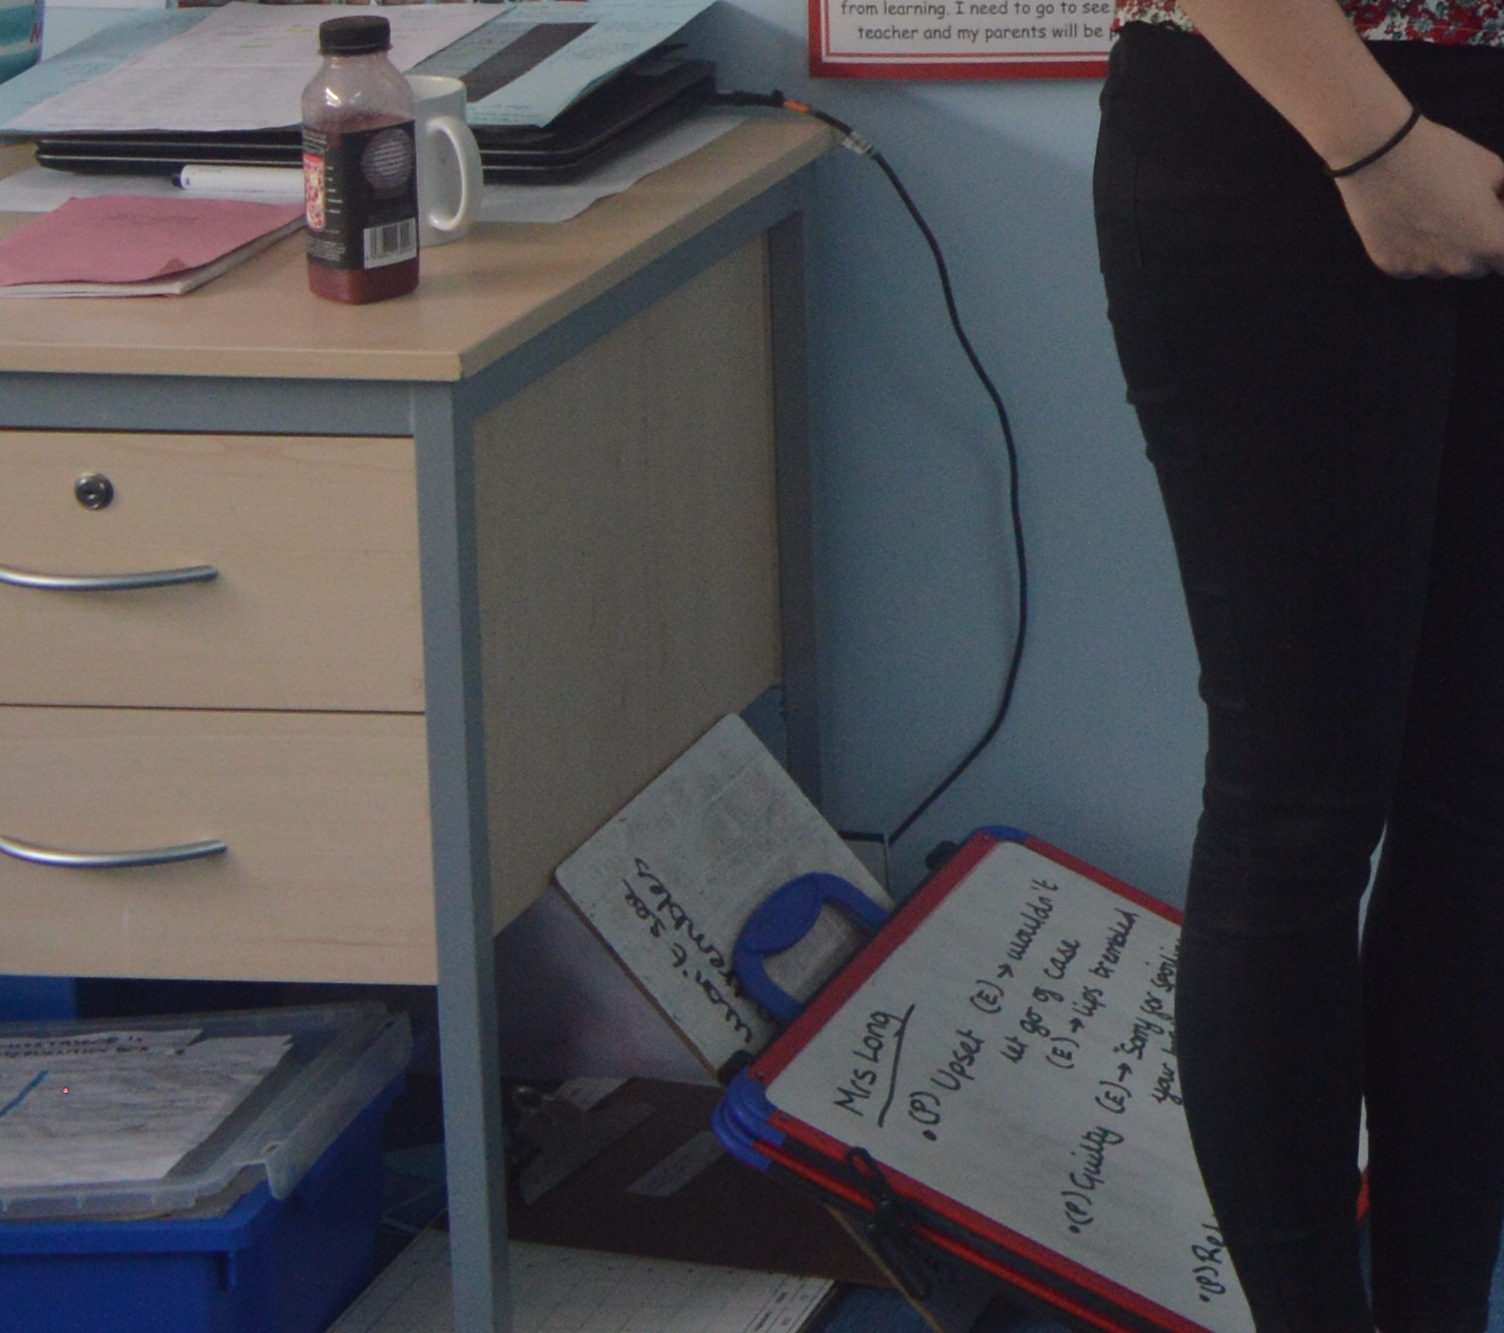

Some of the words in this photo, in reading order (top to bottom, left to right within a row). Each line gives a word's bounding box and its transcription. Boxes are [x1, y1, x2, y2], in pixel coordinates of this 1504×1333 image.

[840, 0, 877, 17] from
[882, 0, 950, 20] learning.
[954, 0, 963, 14] I
[970, 0, 1007, 15] need
[1014, 0, 1031, 15] to
[1035, 3, 1054, 19] go
[1060, 0, 1078, 15] to
[1083, 3, 1111, 15] see
[853, 1011, 903, 1064] Long
